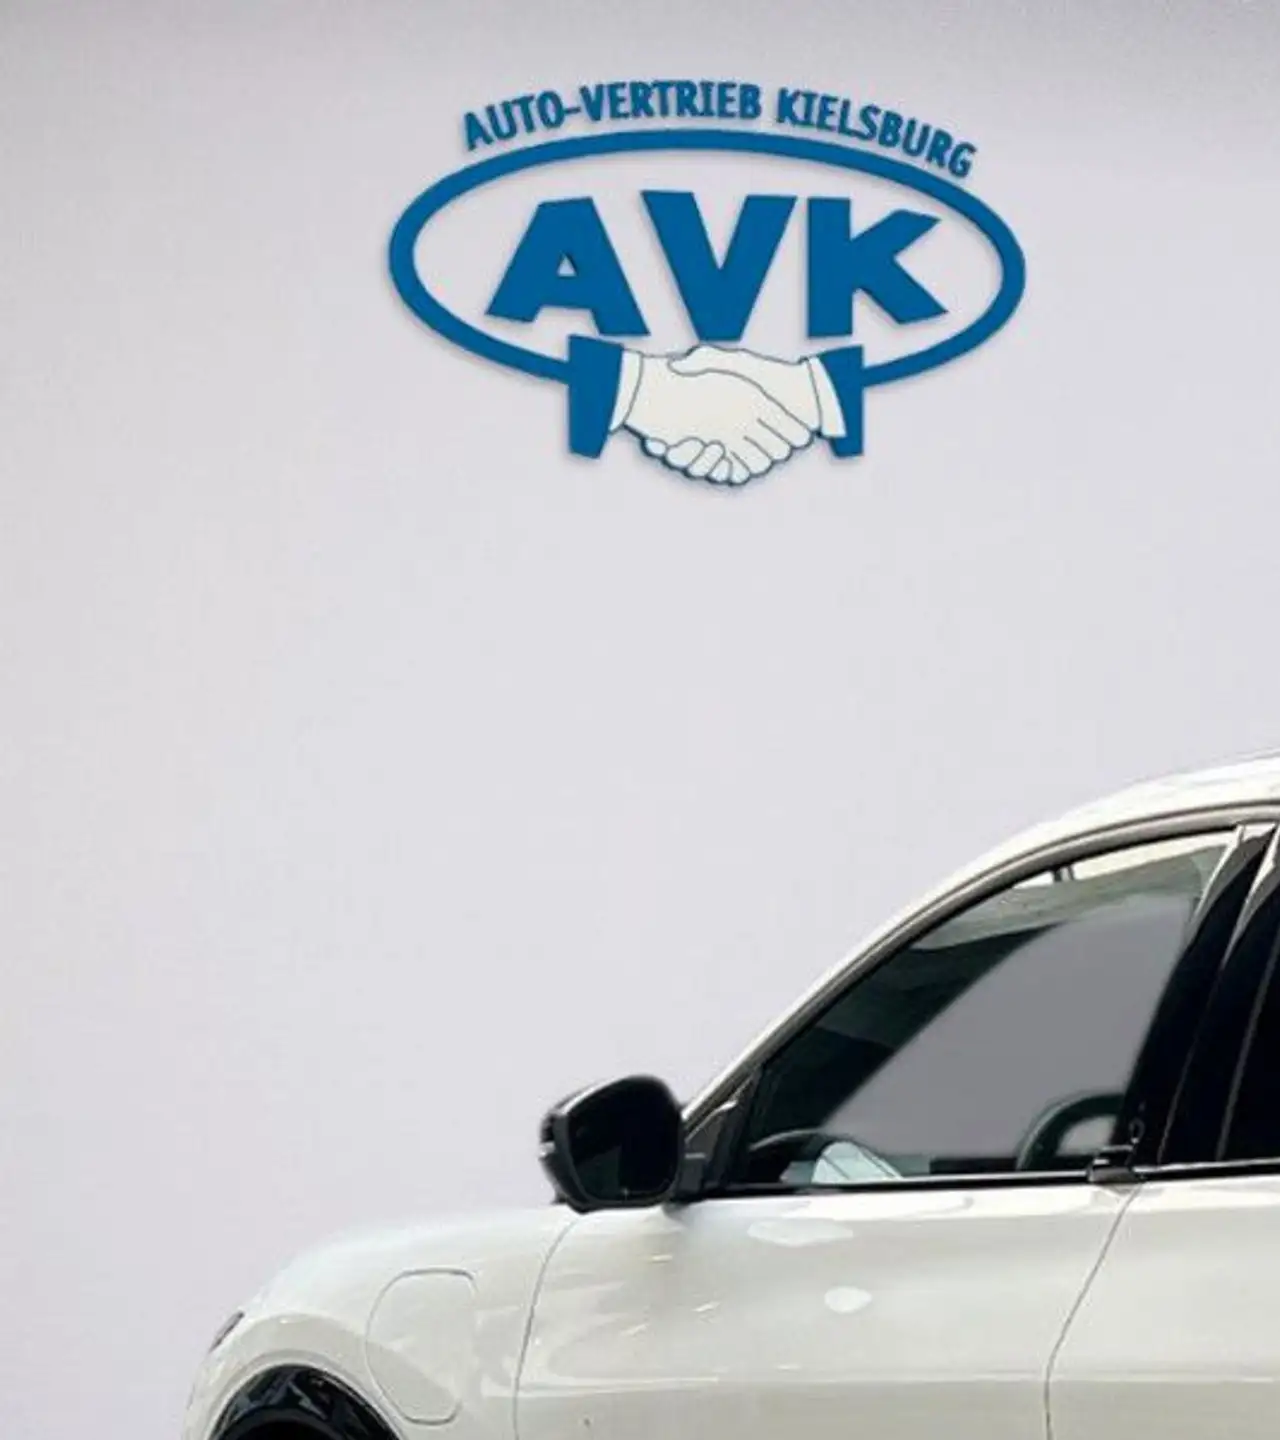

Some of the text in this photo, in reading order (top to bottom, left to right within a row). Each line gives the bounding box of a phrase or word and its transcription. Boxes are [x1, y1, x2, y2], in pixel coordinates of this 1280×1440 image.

[464, 80, 976, 178] AUTO-VERTRIEB KIELSBURG
[485, 190, 948, 342] AVK
